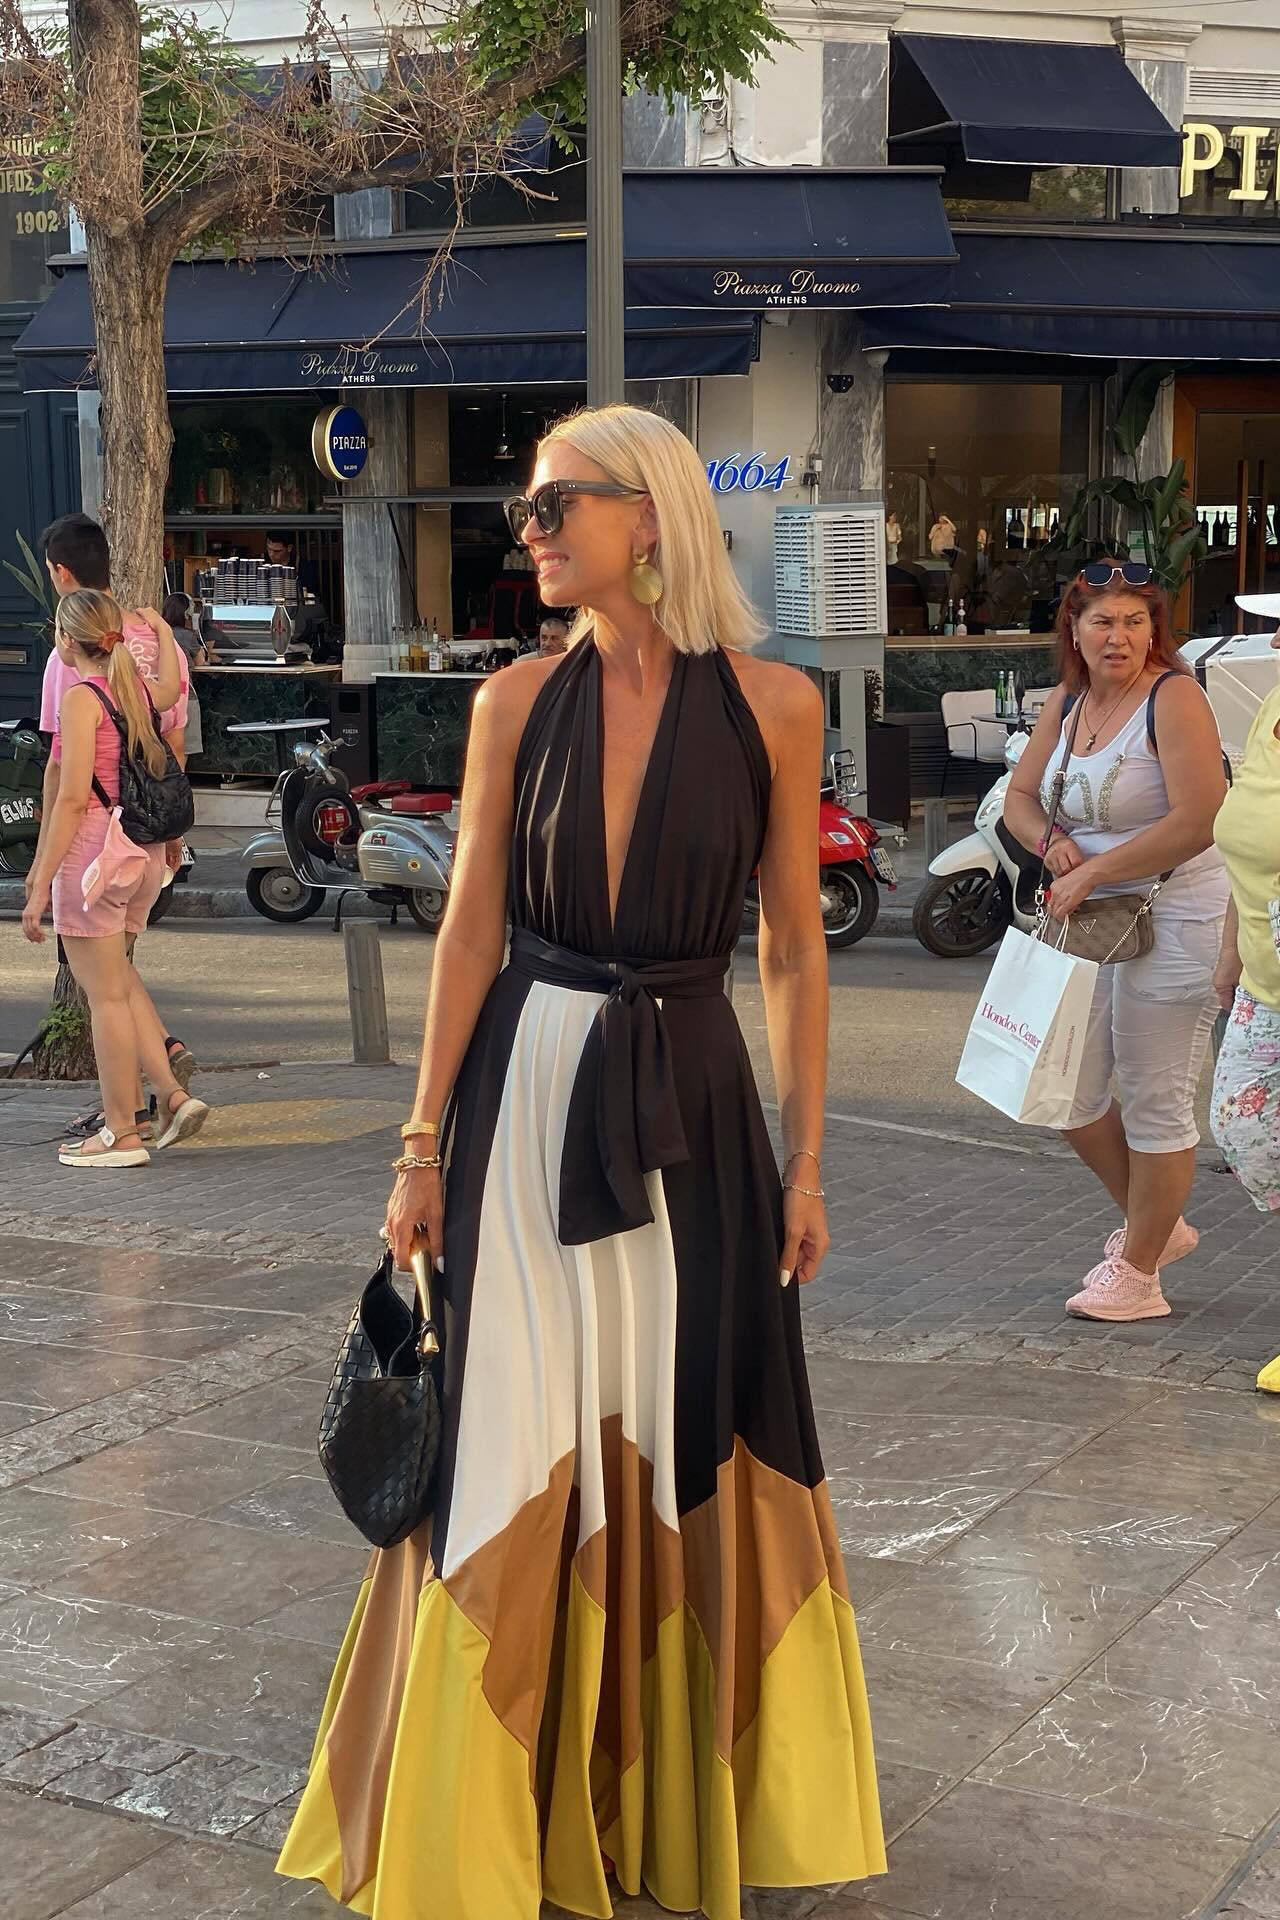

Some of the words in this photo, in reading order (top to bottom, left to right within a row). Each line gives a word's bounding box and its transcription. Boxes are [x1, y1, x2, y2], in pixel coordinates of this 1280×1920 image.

[1180, 123, 1280, 201] PI
[16, 209, 60, 235] 1902
[713, 270, 783, 295] Piazza
[789, 269, 862, 294] Duomo
[766, 295, 808, 304] ATHENS
[300, 352, 354, 376] Piazza
[362, 351, 419, 375] Duomo
[342, 375, 376, 383] ATHENS
[332, 436, 367, 450] PIAZZA
[705, 451, 794, 493] 1664
[981, 1001, 1019, 1034] Hondos
[1019, 1022, 1042, 1049] Center
